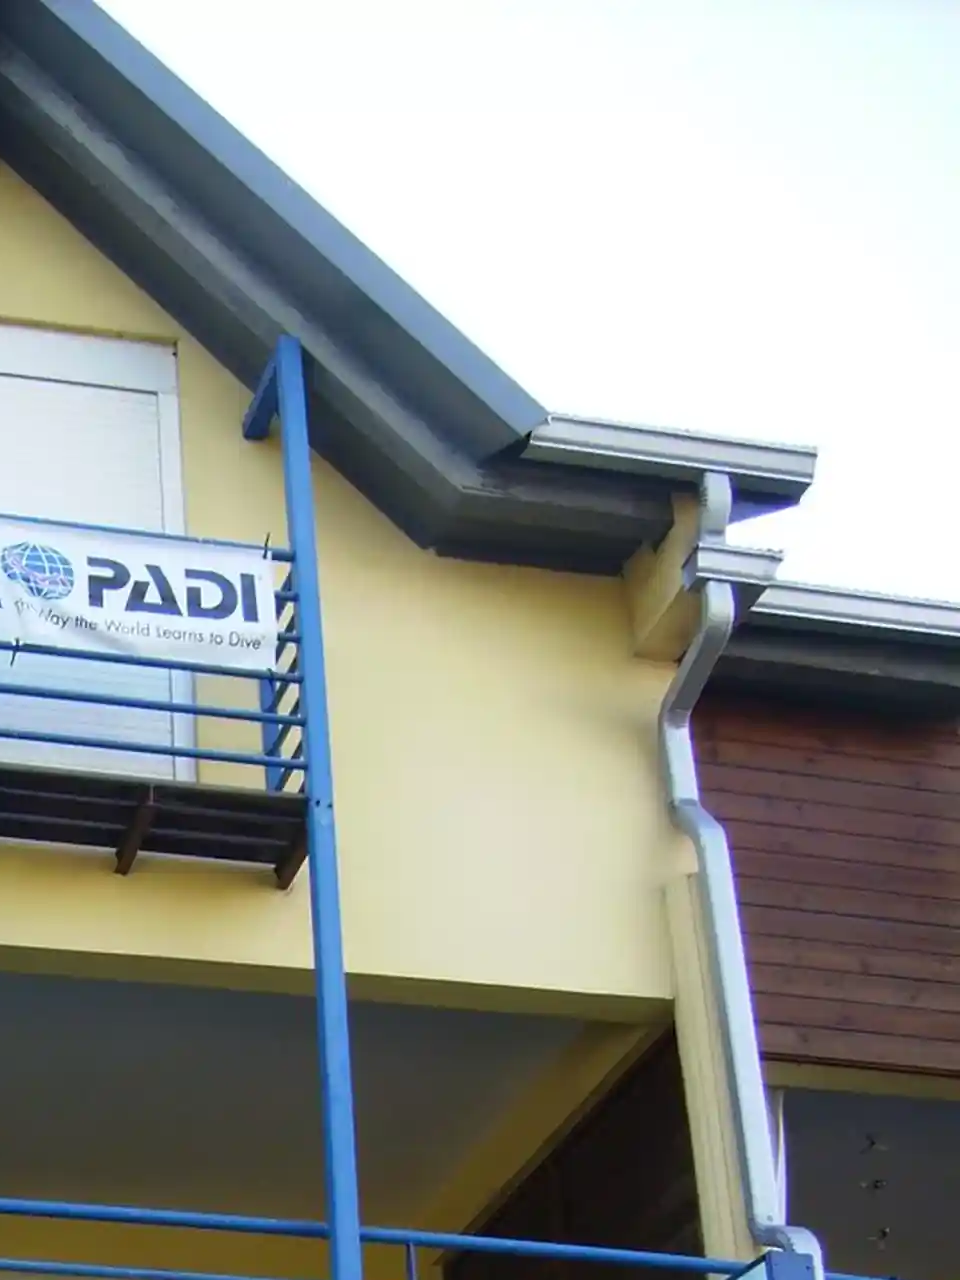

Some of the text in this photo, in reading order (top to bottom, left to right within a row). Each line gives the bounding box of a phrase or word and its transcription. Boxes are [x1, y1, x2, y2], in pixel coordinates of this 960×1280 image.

[86, 556, 259, 623] PADI
[74, 614, 98, 631] the
[104, 618, 152, 638] World
[155, 625, 205, 644] Learns
[208, 631, 224, 646] to
[228, 630, 263, 650] Dive
